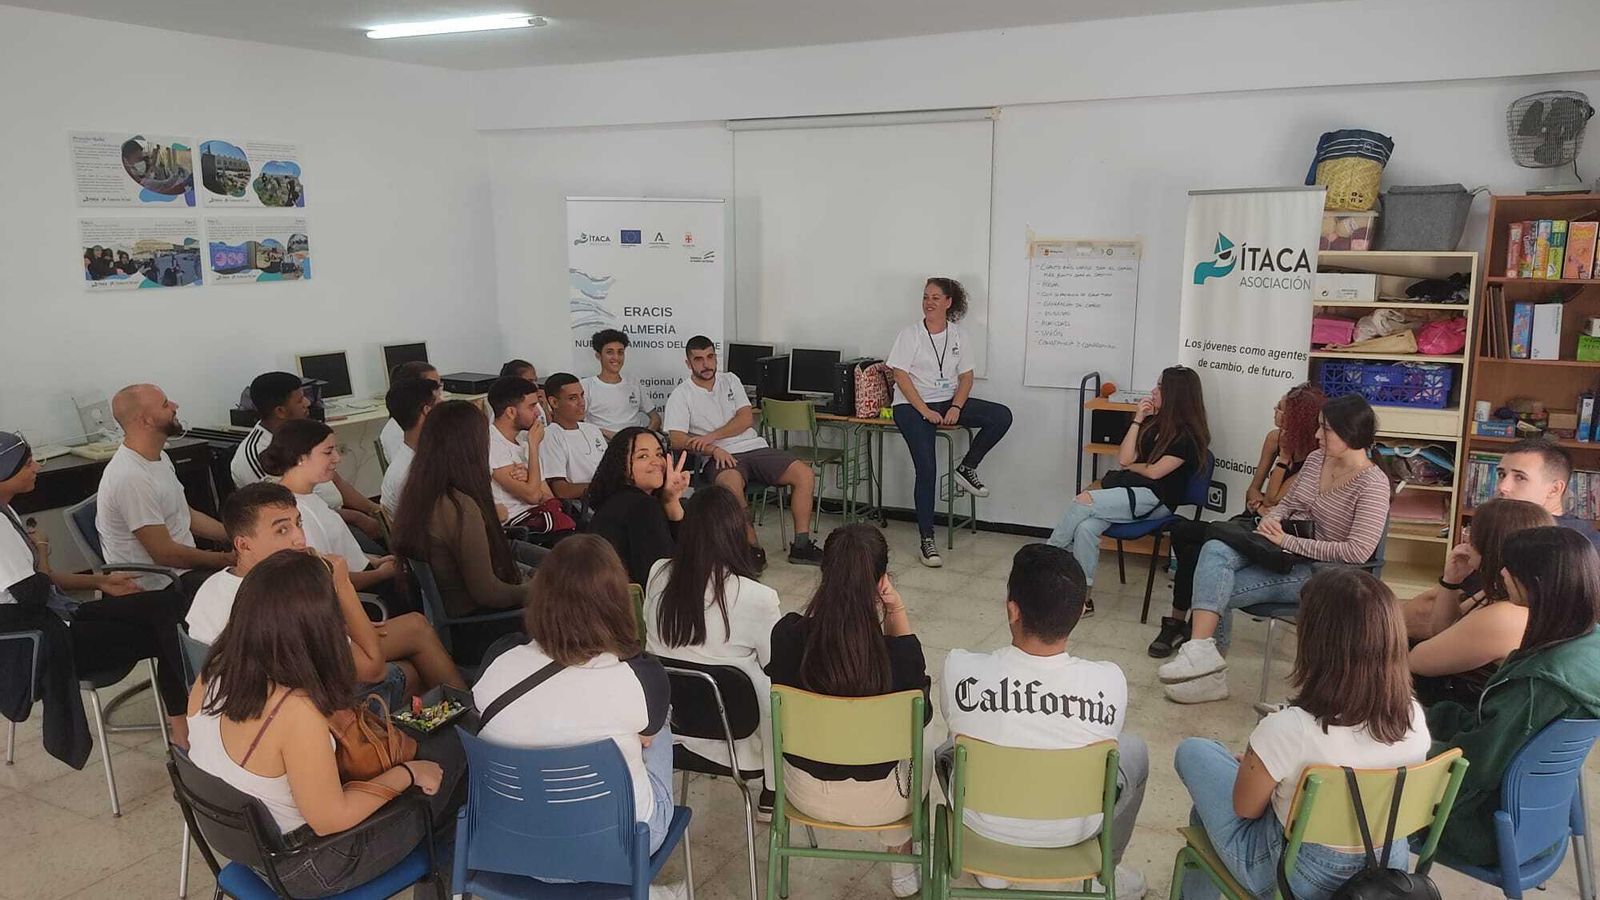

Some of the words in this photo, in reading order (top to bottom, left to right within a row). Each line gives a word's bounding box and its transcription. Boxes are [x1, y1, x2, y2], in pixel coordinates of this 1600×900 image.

[1240, 242, 1311, 273] ÍTACA
[1239, 276, 1311, 290] ASOCIACIÓN
[624, 306, 673, 317] ERACIS
[622, 323, 676, 334] ALMERÍA
[628, 341, 664, 349] AMINOS
[1184, 338, 1201, 349] Los
[1202, 340, 1237, 354] jóvenes
[1239, 346, 1266, 356] como
[1268, 349, 1307, 361] agentes
[1197, 358, 1208, 368] de
[1209, 360, 1244, 374] cambio,
[1247, 364, 1259, 375] de
[1261, 367, 1295, 380] futuro.
[640, 377, 674, 388] egional
[955, 676, 1118, 726] California
